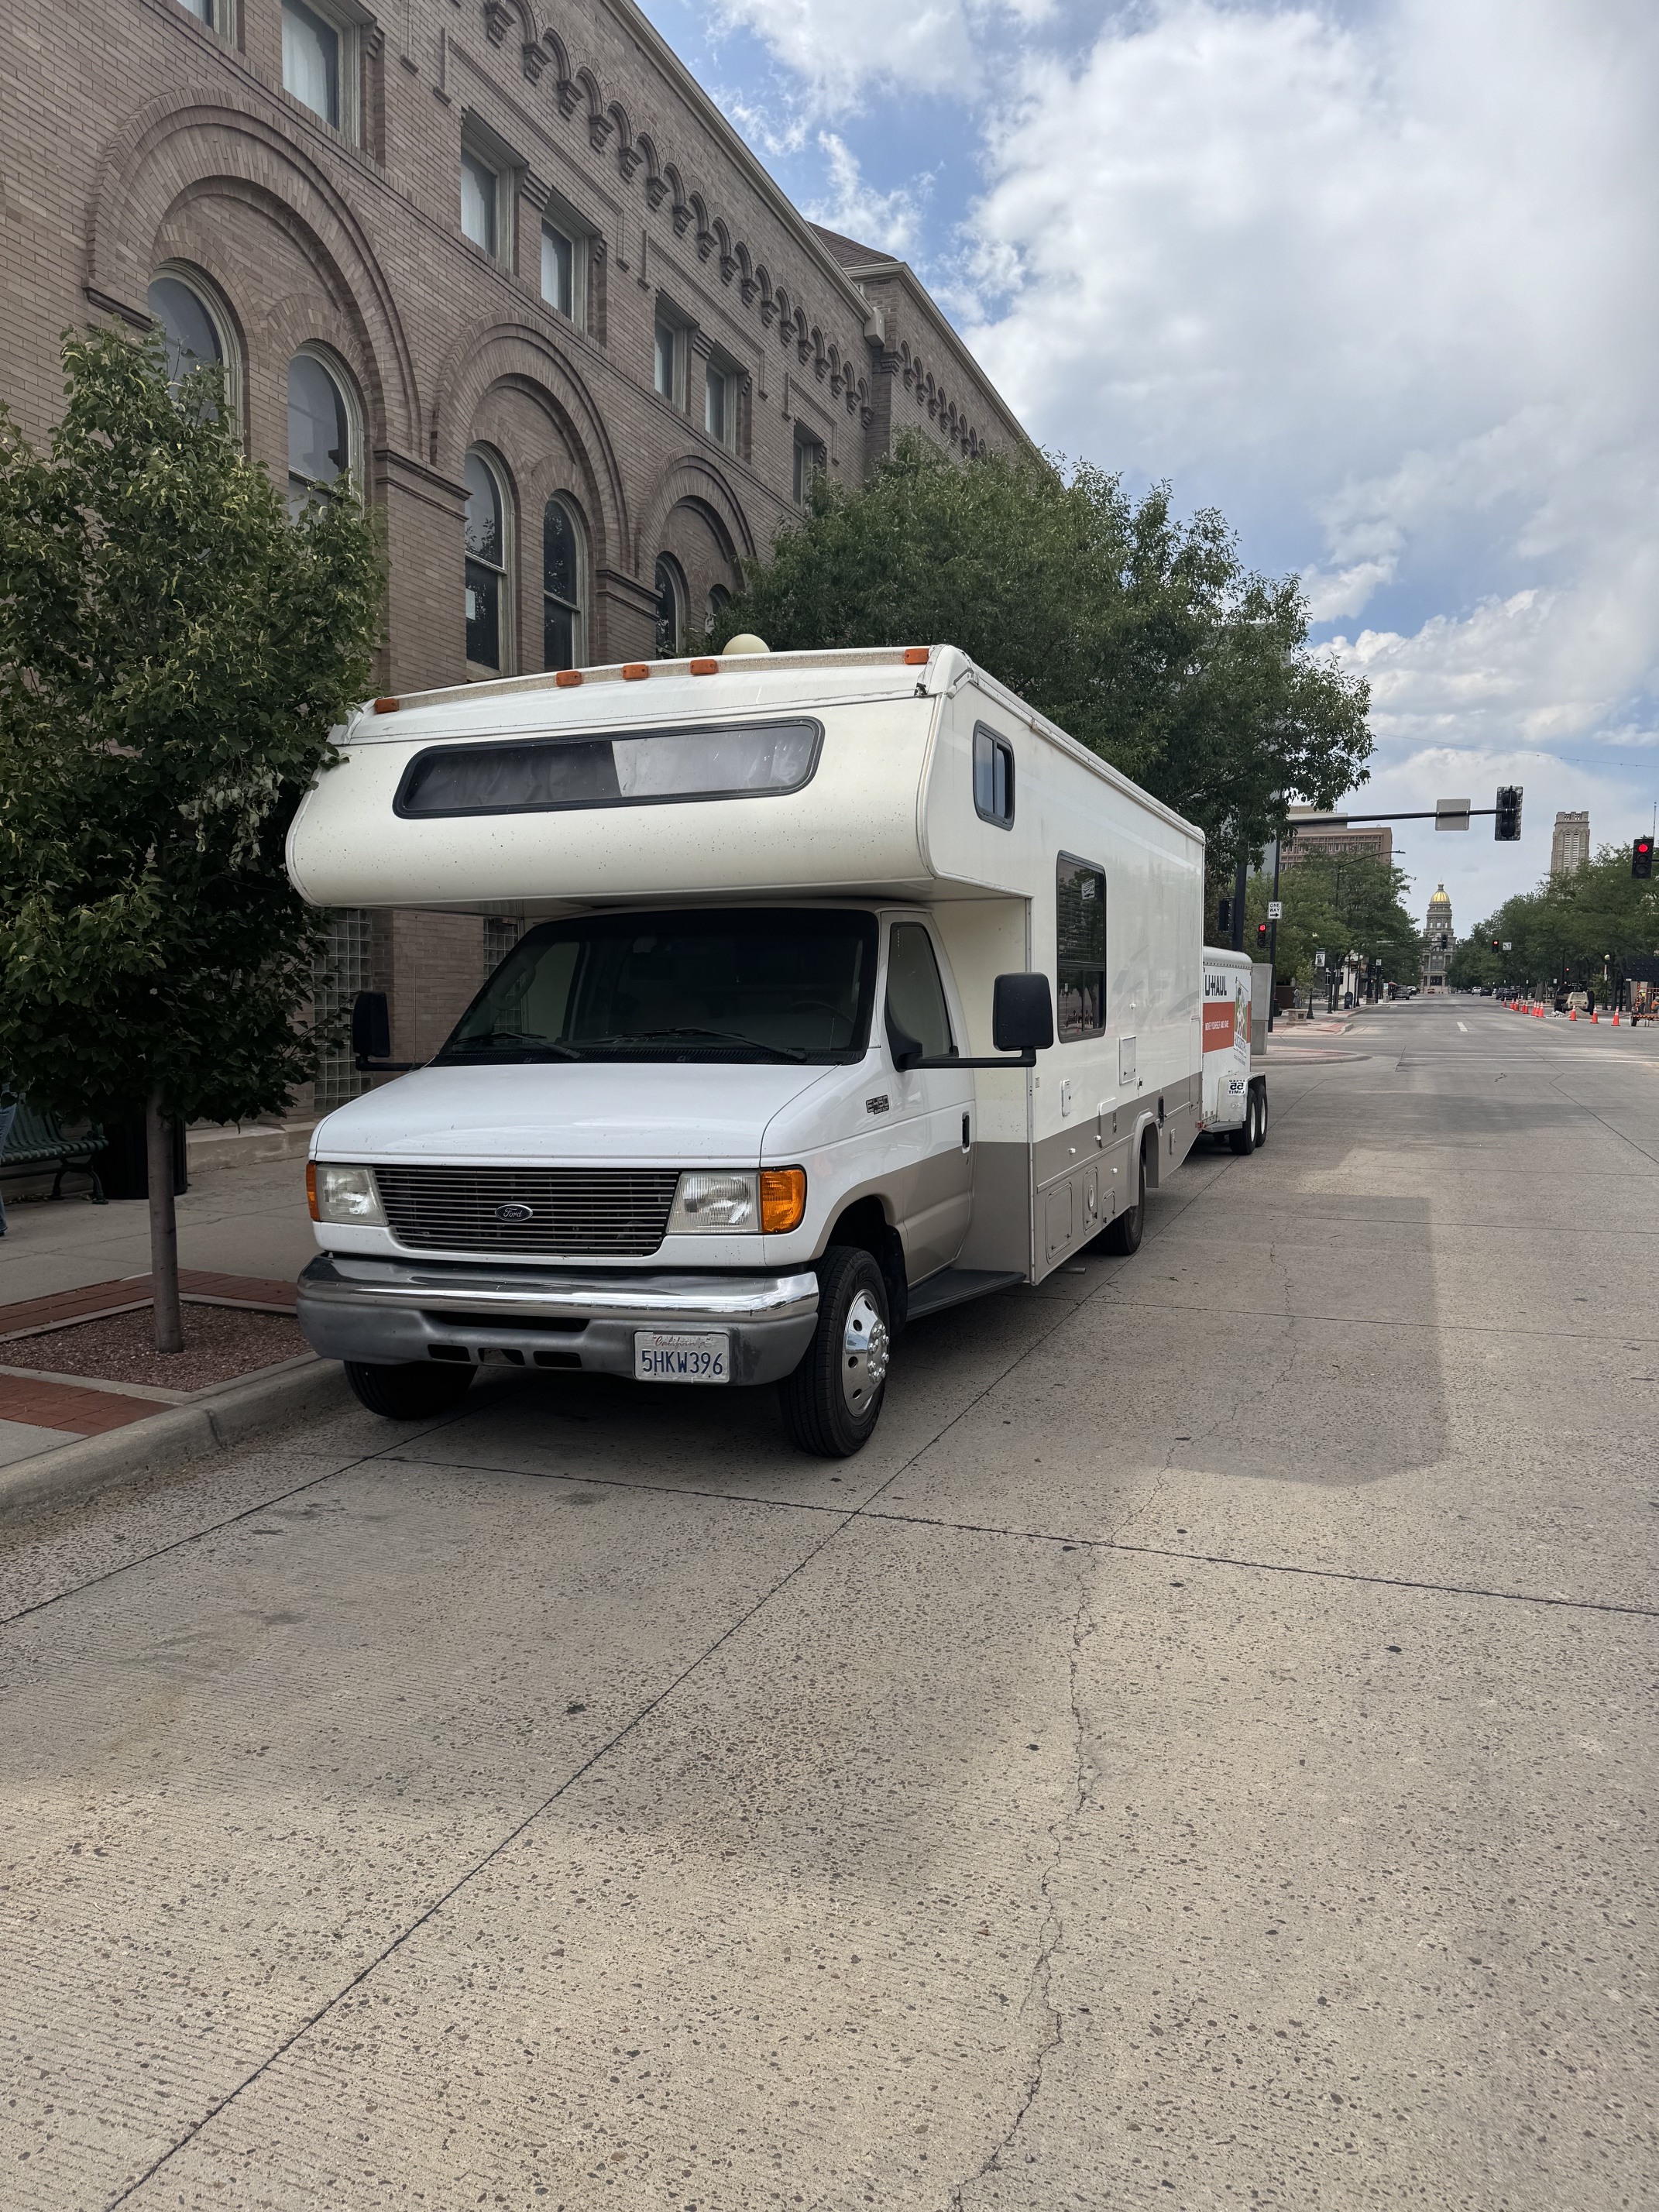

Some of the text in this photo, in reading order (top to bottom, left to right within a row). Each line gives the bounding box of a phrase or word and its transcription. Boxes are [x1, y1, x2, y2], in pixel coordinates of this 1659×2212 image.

[867, 1095, 889, 1112] E450
[503, 1207, 523, 1218] Ford
[641, 1349, 723, 1376] 5HKW396
